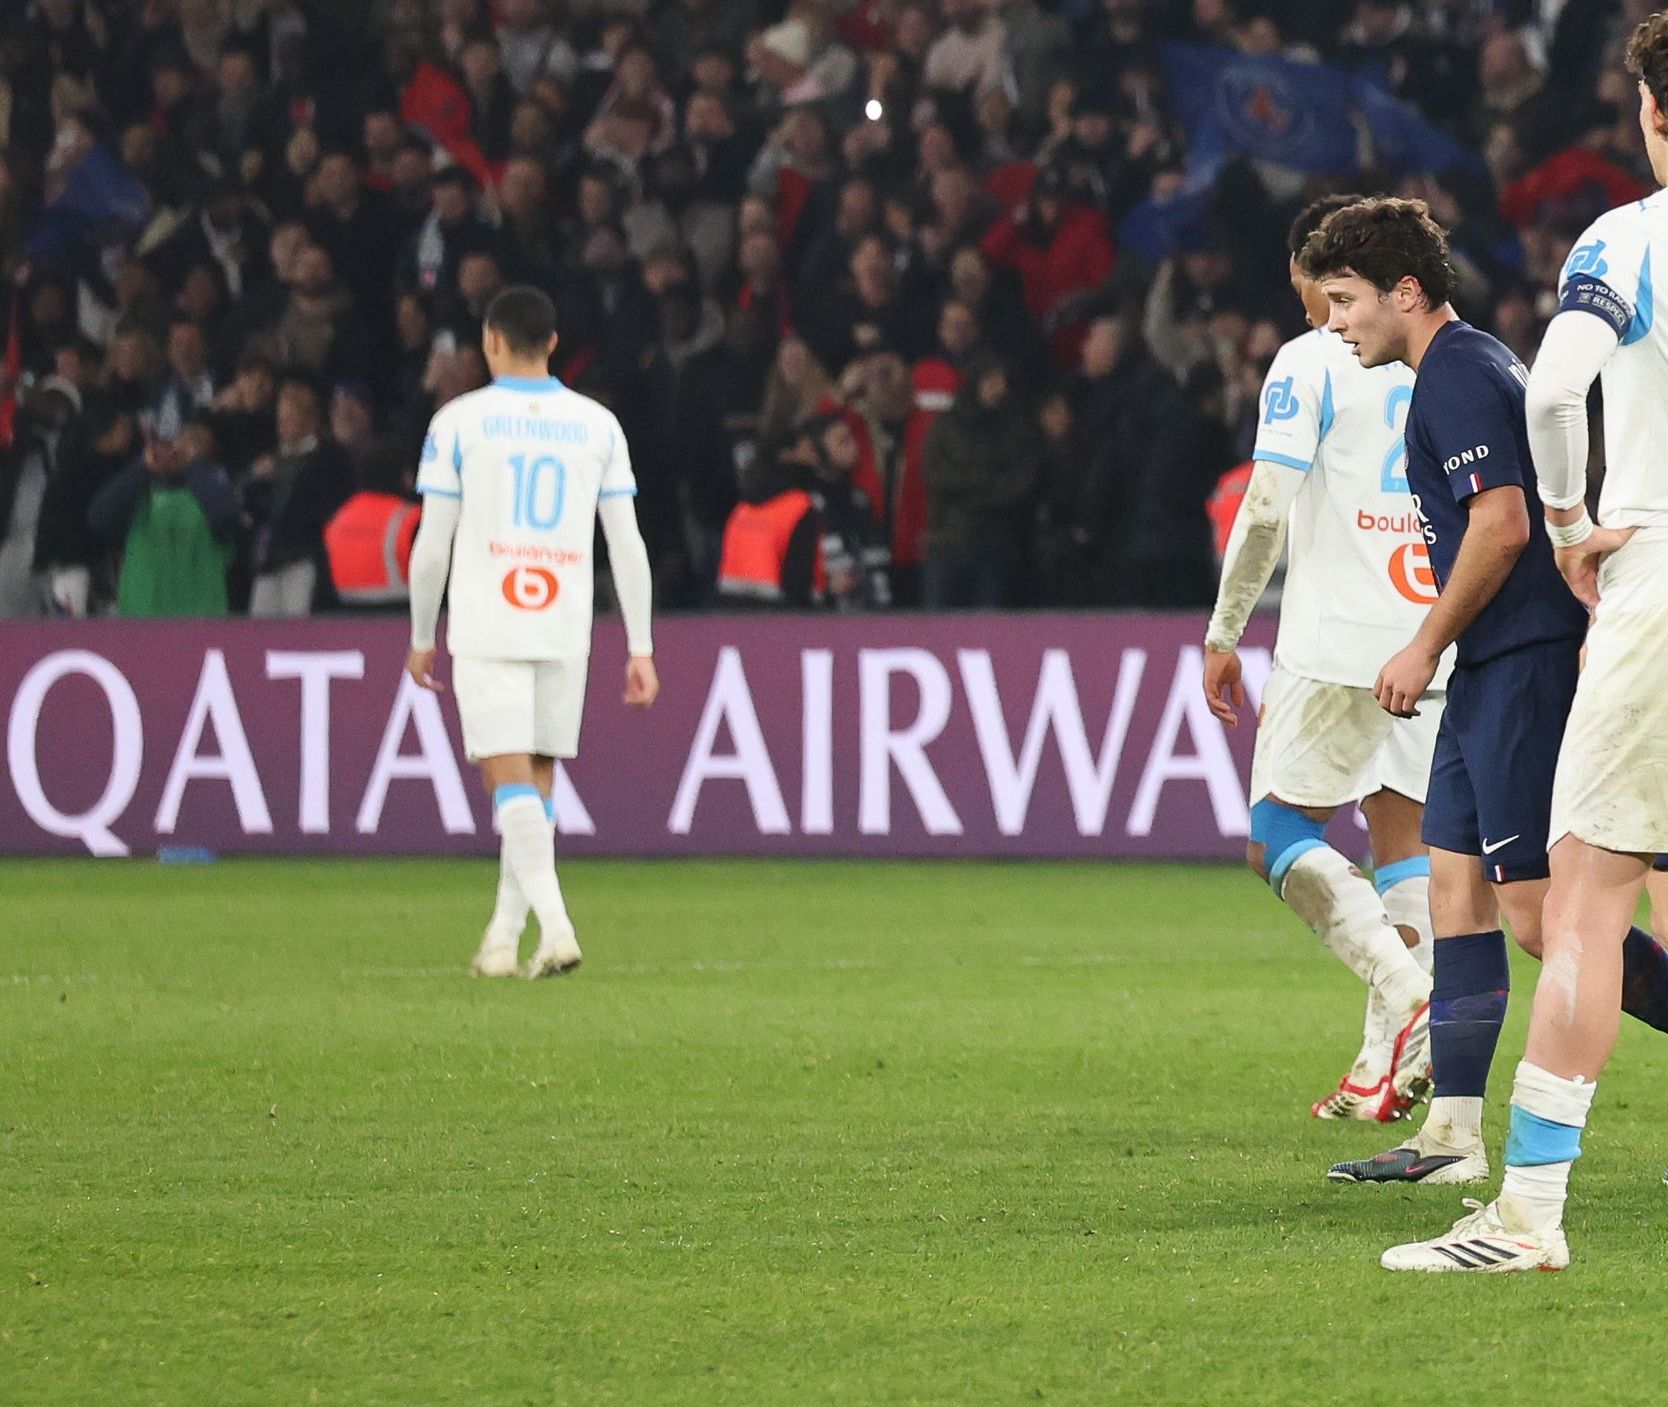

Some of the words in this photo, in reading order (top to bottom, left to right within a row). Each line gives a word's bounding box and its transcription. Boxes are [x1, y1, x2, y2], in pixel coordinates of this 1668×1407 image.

[507, 453, 567, 532] 10
[8, 648, 597, 858] QATA
[668, 645, 1273, 838] AIRWA
